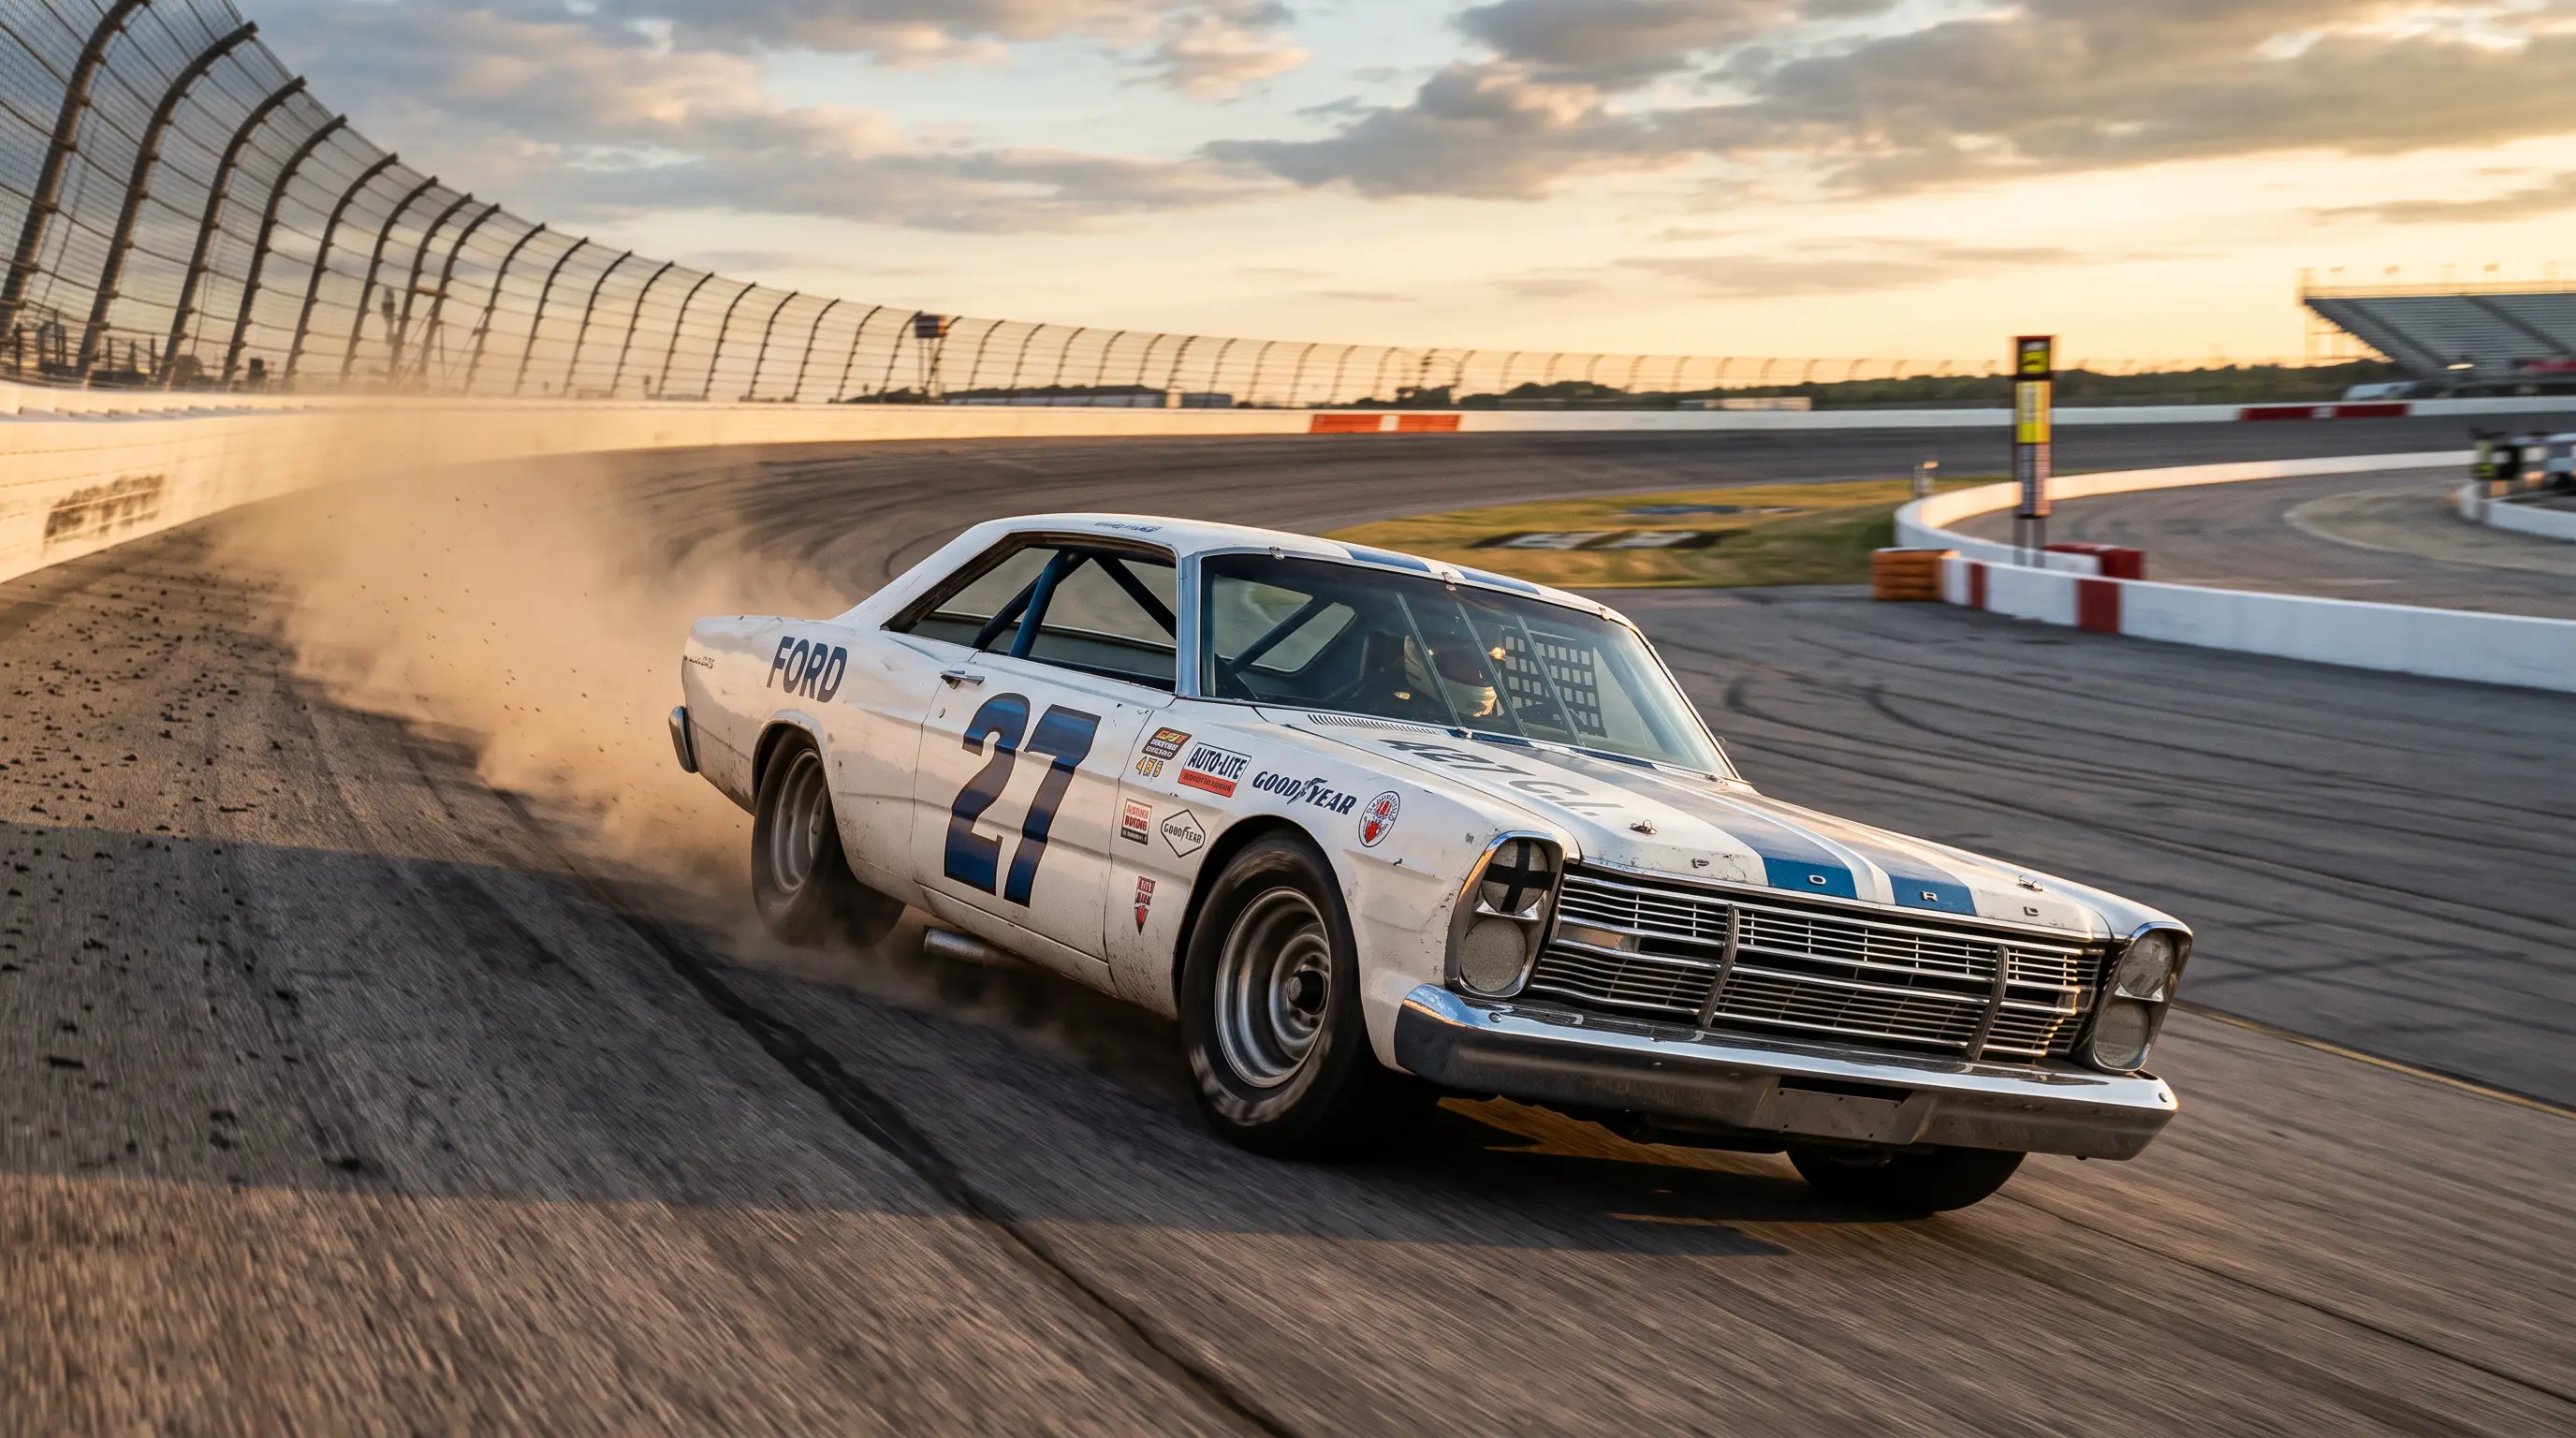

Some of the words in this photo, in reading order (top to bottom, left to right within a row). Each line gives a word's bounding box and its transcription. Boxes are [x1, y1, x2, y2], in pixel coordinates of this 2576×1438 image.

[767, 636, 848, 704] FORD
[1377, 739, 1537, 776] 427
[944, 692, 1102, 908] 27
[1251, 770, 1357, 815] GOODYEAR
